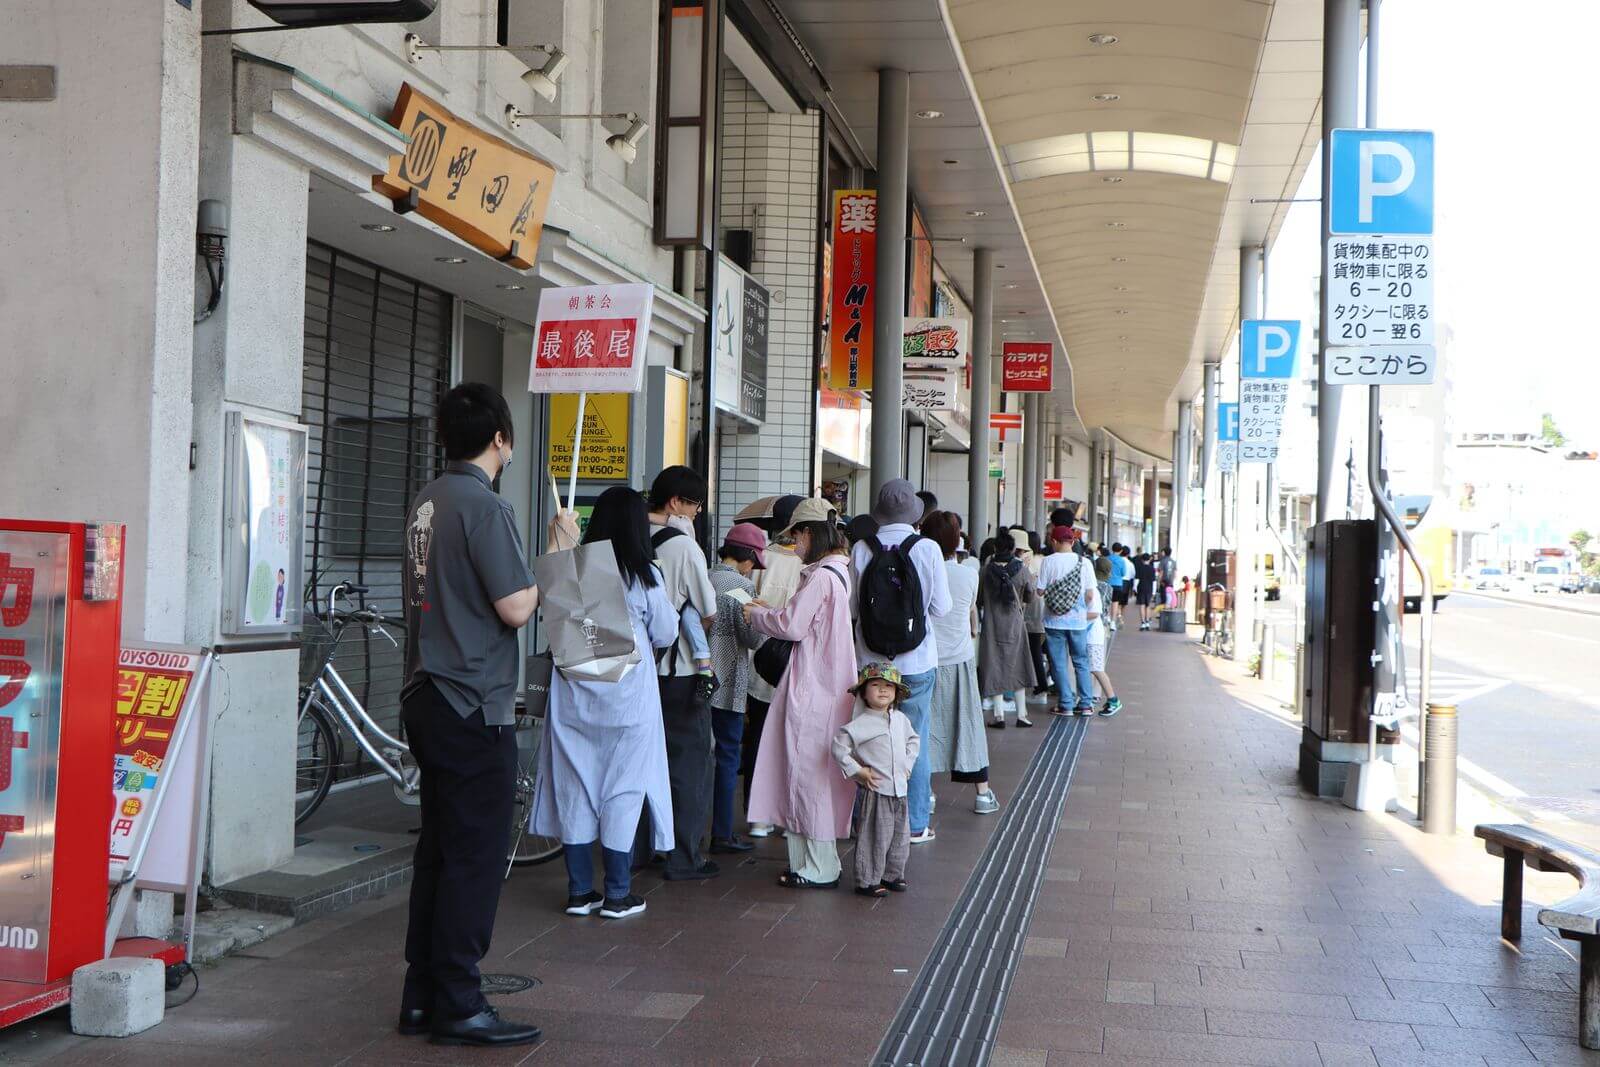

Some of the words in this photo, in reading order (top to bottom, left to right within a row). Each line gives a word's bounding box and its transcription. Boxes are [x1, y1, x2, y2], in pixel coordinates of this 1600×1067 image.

[1358, 141, 1416, 223] P
[841, 195, 876, 234] 薬
[1333, 243, 1429, 259] 貨物集配中の
[1333, 263, 1428, 279] 貨物車に限る
[568, 294, 612, 310] 朝茶会
[1334, 303, 1429, 320] タクシーに限る
[540, 328, 631, 359] 最後尾
[1257, 326, 1292, 373] P
[1006, 352, 1048, 363] カラオケ
[1333, 354, 1428, 376] ここから
[119, 649, 190, 668] OYSOUND
[114, 819, 133, 837] 円
